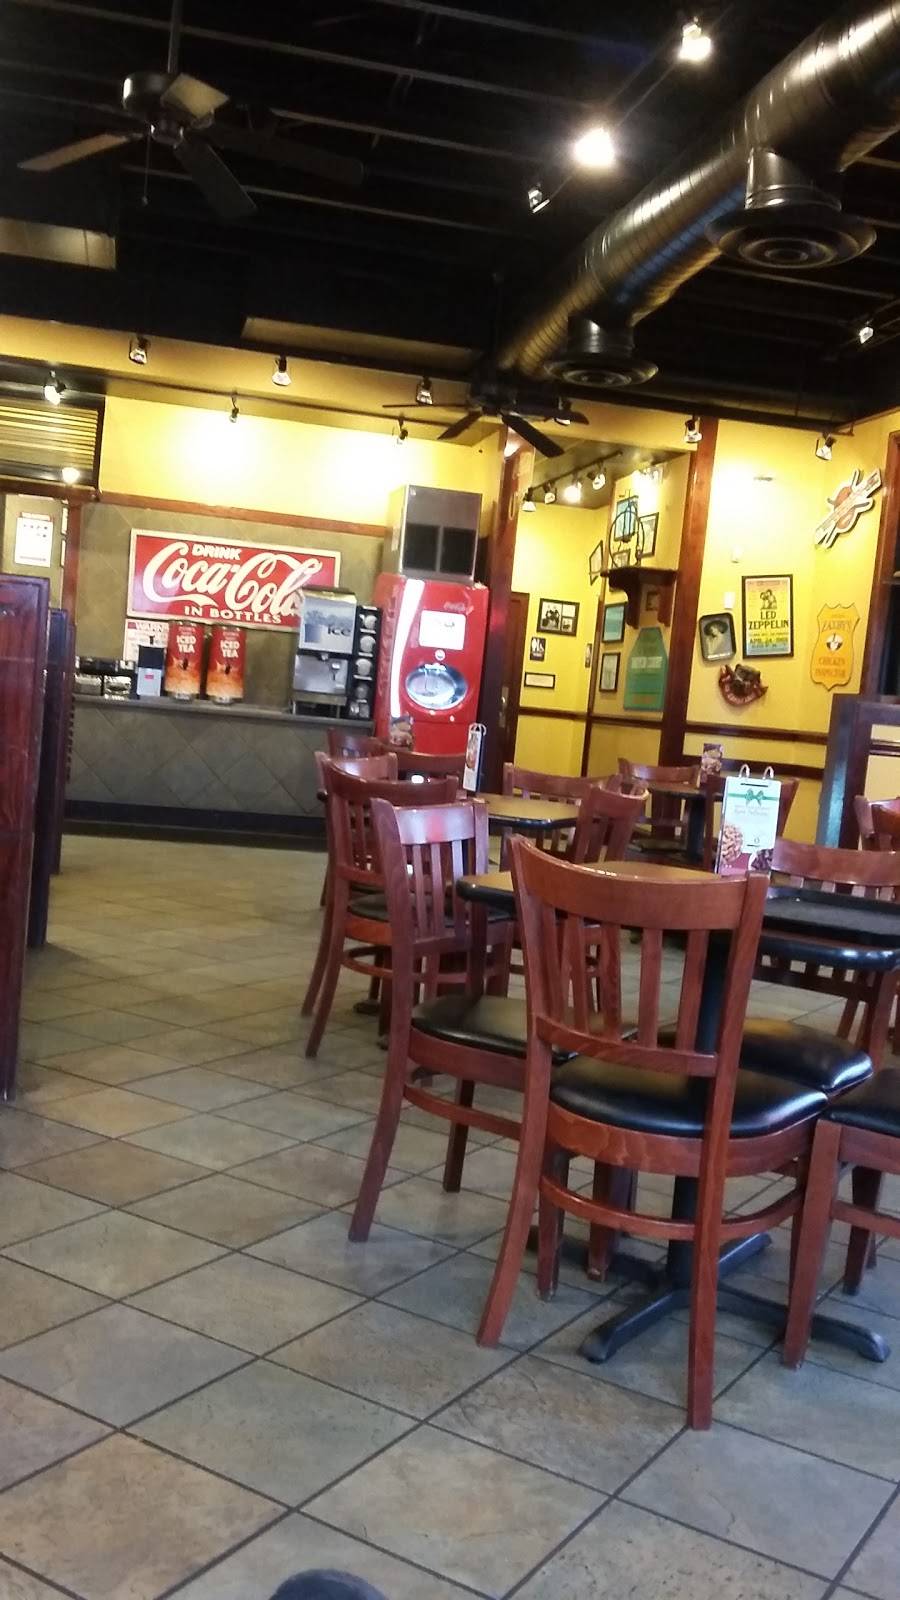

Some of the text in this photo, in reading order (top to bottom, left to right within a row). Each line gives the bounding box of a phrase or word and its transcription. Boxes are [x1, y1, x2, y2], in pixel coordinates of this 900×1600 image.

[192, 543, 242, 561] DRINK
[184, 605, 282, 624] IN BOTTLES
[760, 611, 777, 620] LED
[749, 619, 789, 630] ZEPPELIN
[176, 635, 197, 645] ICED
[220, 640, 240, 650] ICED
[178, 643, 196, 653] TEA
[222, 649, 239, 658] TEA
